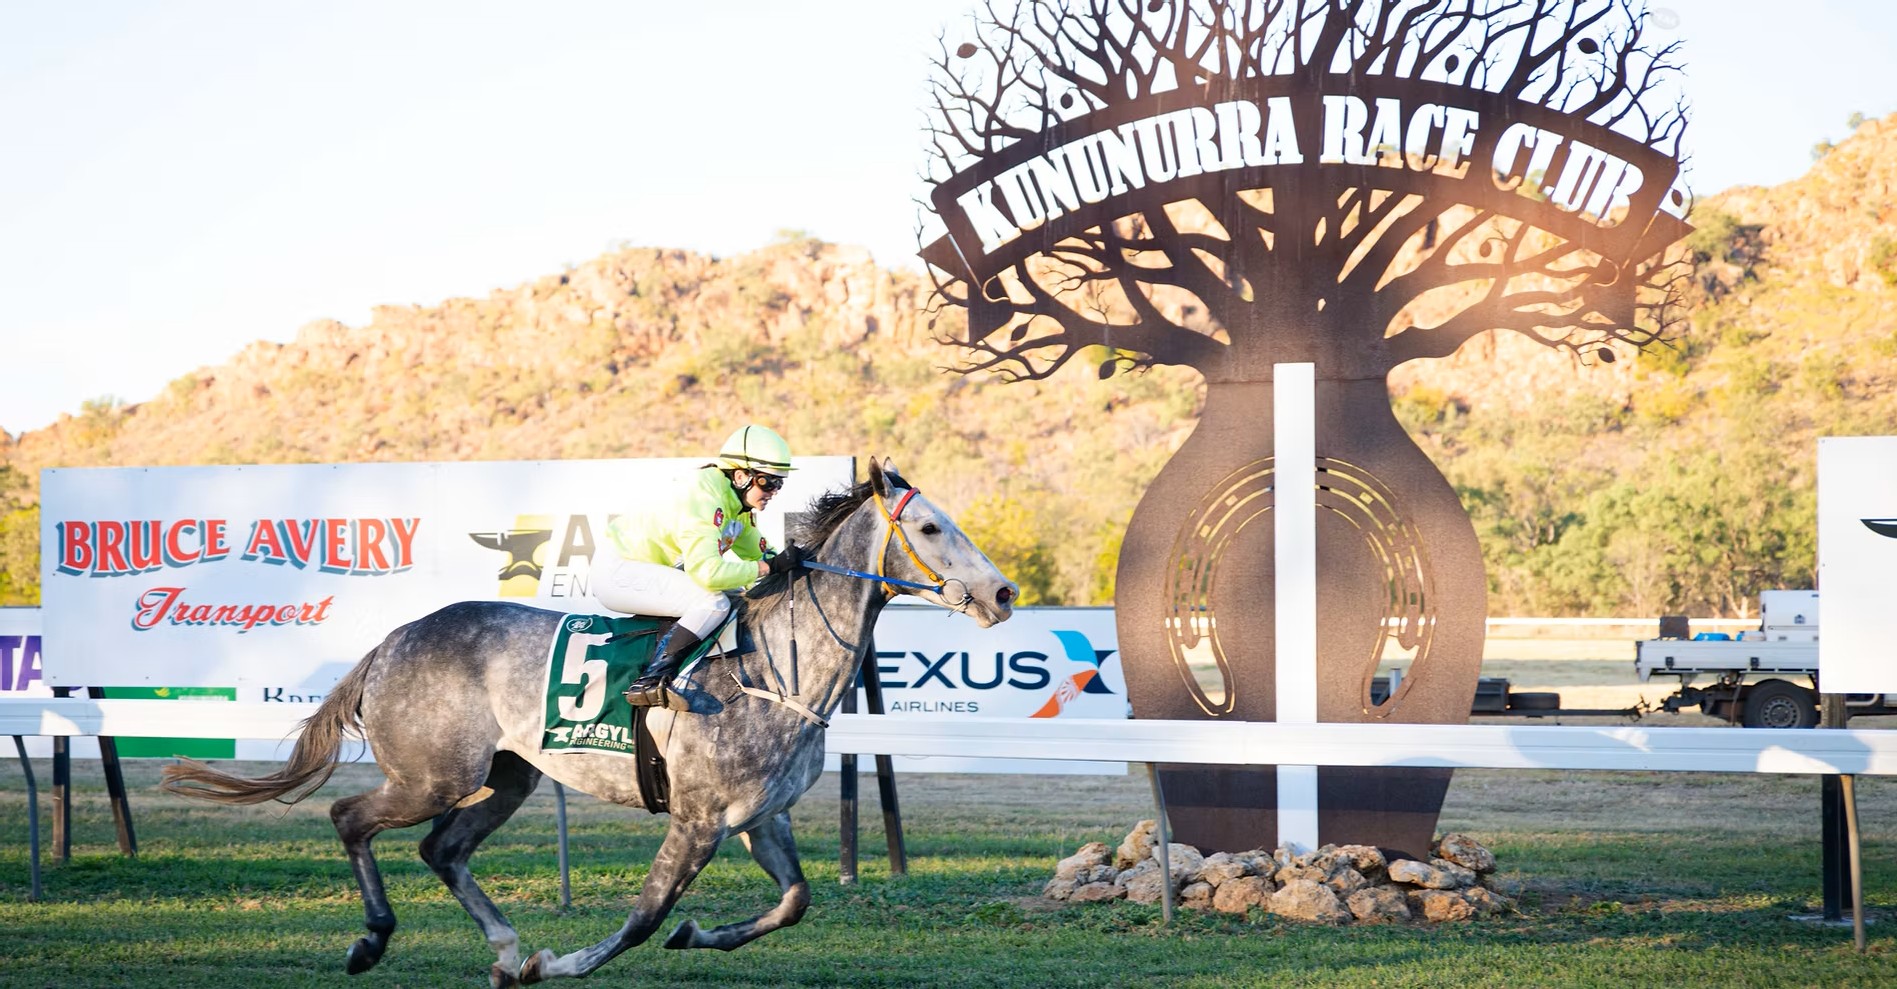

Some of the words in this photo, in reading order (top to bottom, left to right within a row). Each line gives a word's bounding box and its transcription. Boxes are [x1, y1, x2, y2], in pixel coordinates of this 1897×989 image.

[956, 96, 1304, 255] KUNUNURRA
[1320, 95, 1480, 180] RACE
[1491, 122, 1644, 228] CLUB
[56, 519, 232, 578] BRUCE
[240, 517, 421, 576] AVERY
[131, 587, 335, 634] Transport
[558, 632, 613, 722] 5
[571, 722, 634, 744] ARGYL
[890, 701, 979, 713] AIRLINES
